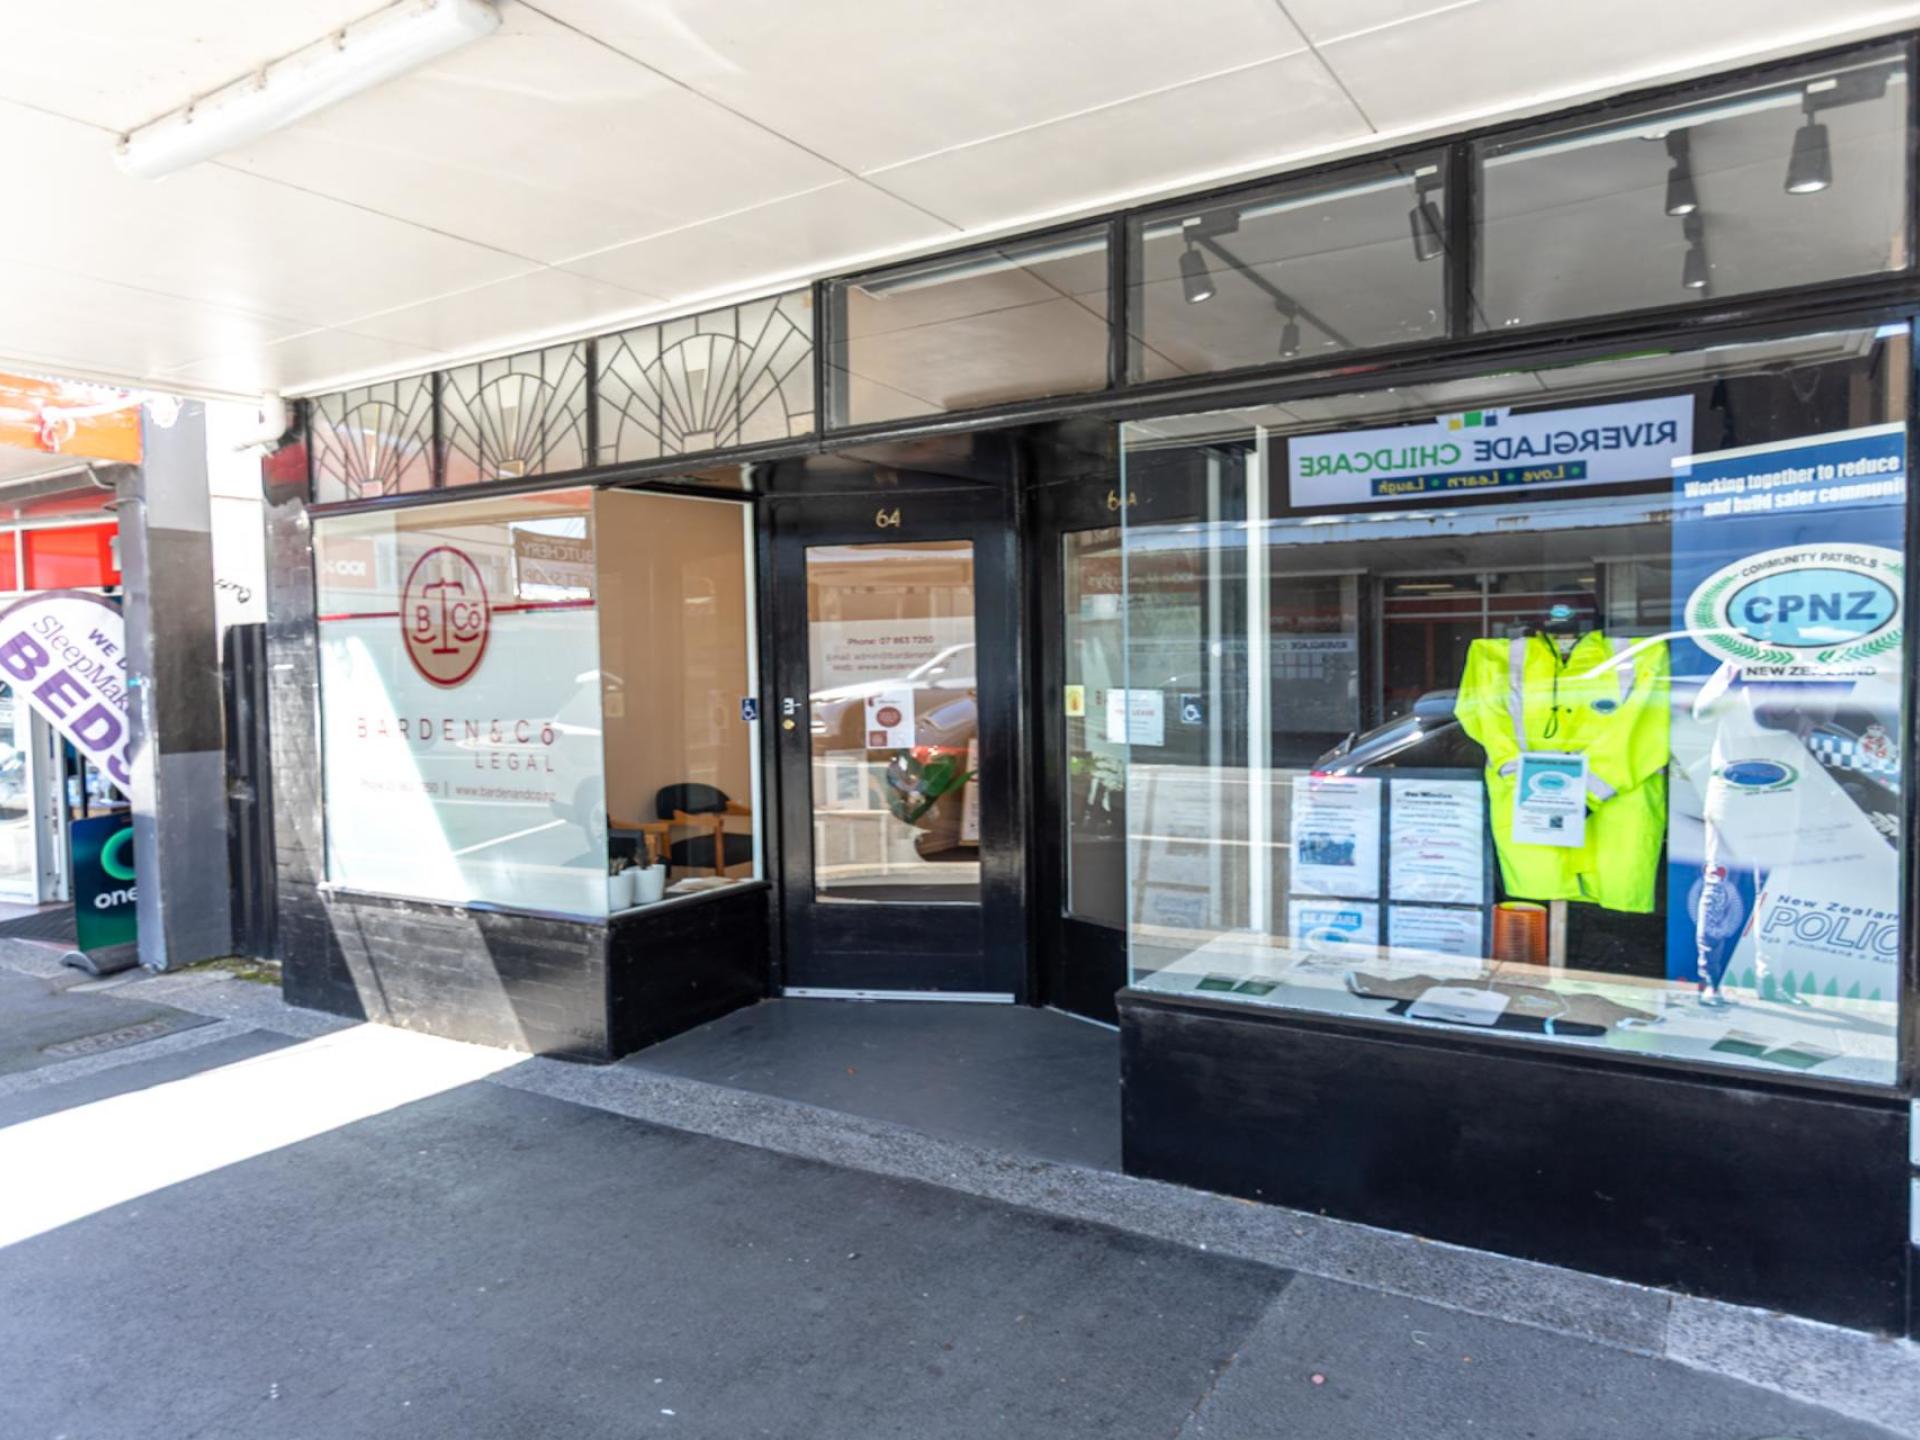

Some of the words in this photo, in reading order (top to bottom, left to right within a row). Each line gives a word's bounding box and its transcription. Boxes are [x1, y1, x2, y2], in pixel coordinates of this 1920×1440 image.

[1684, 475, 1746, 498] Working
[1748, 467, 1814, 491] together
[1817, 464, 1835, 481] to
[1837, 455, 1900, 478] reduce
[1107, 489, 1137, 512] 6A
[1703, 497, 1732, 516] and
[1733, 492, 1773, 513] build
[1775, 489, 1817, 509] safer
[876, 508, 900, 528] 64
[1741, 552, 1818, 577] COMMUNITY
[1820, 552, 1879, 569] PATROLS
[416, 605, 431, 632] B
[1743, 590, 1878, 625] CPNZ
[88, 628, 118, 657] WE
[1745, 665, 1784, 677] NEW
[474, 752, 555, 773] LEGAL
[1777, 894, 1818, 909] New
